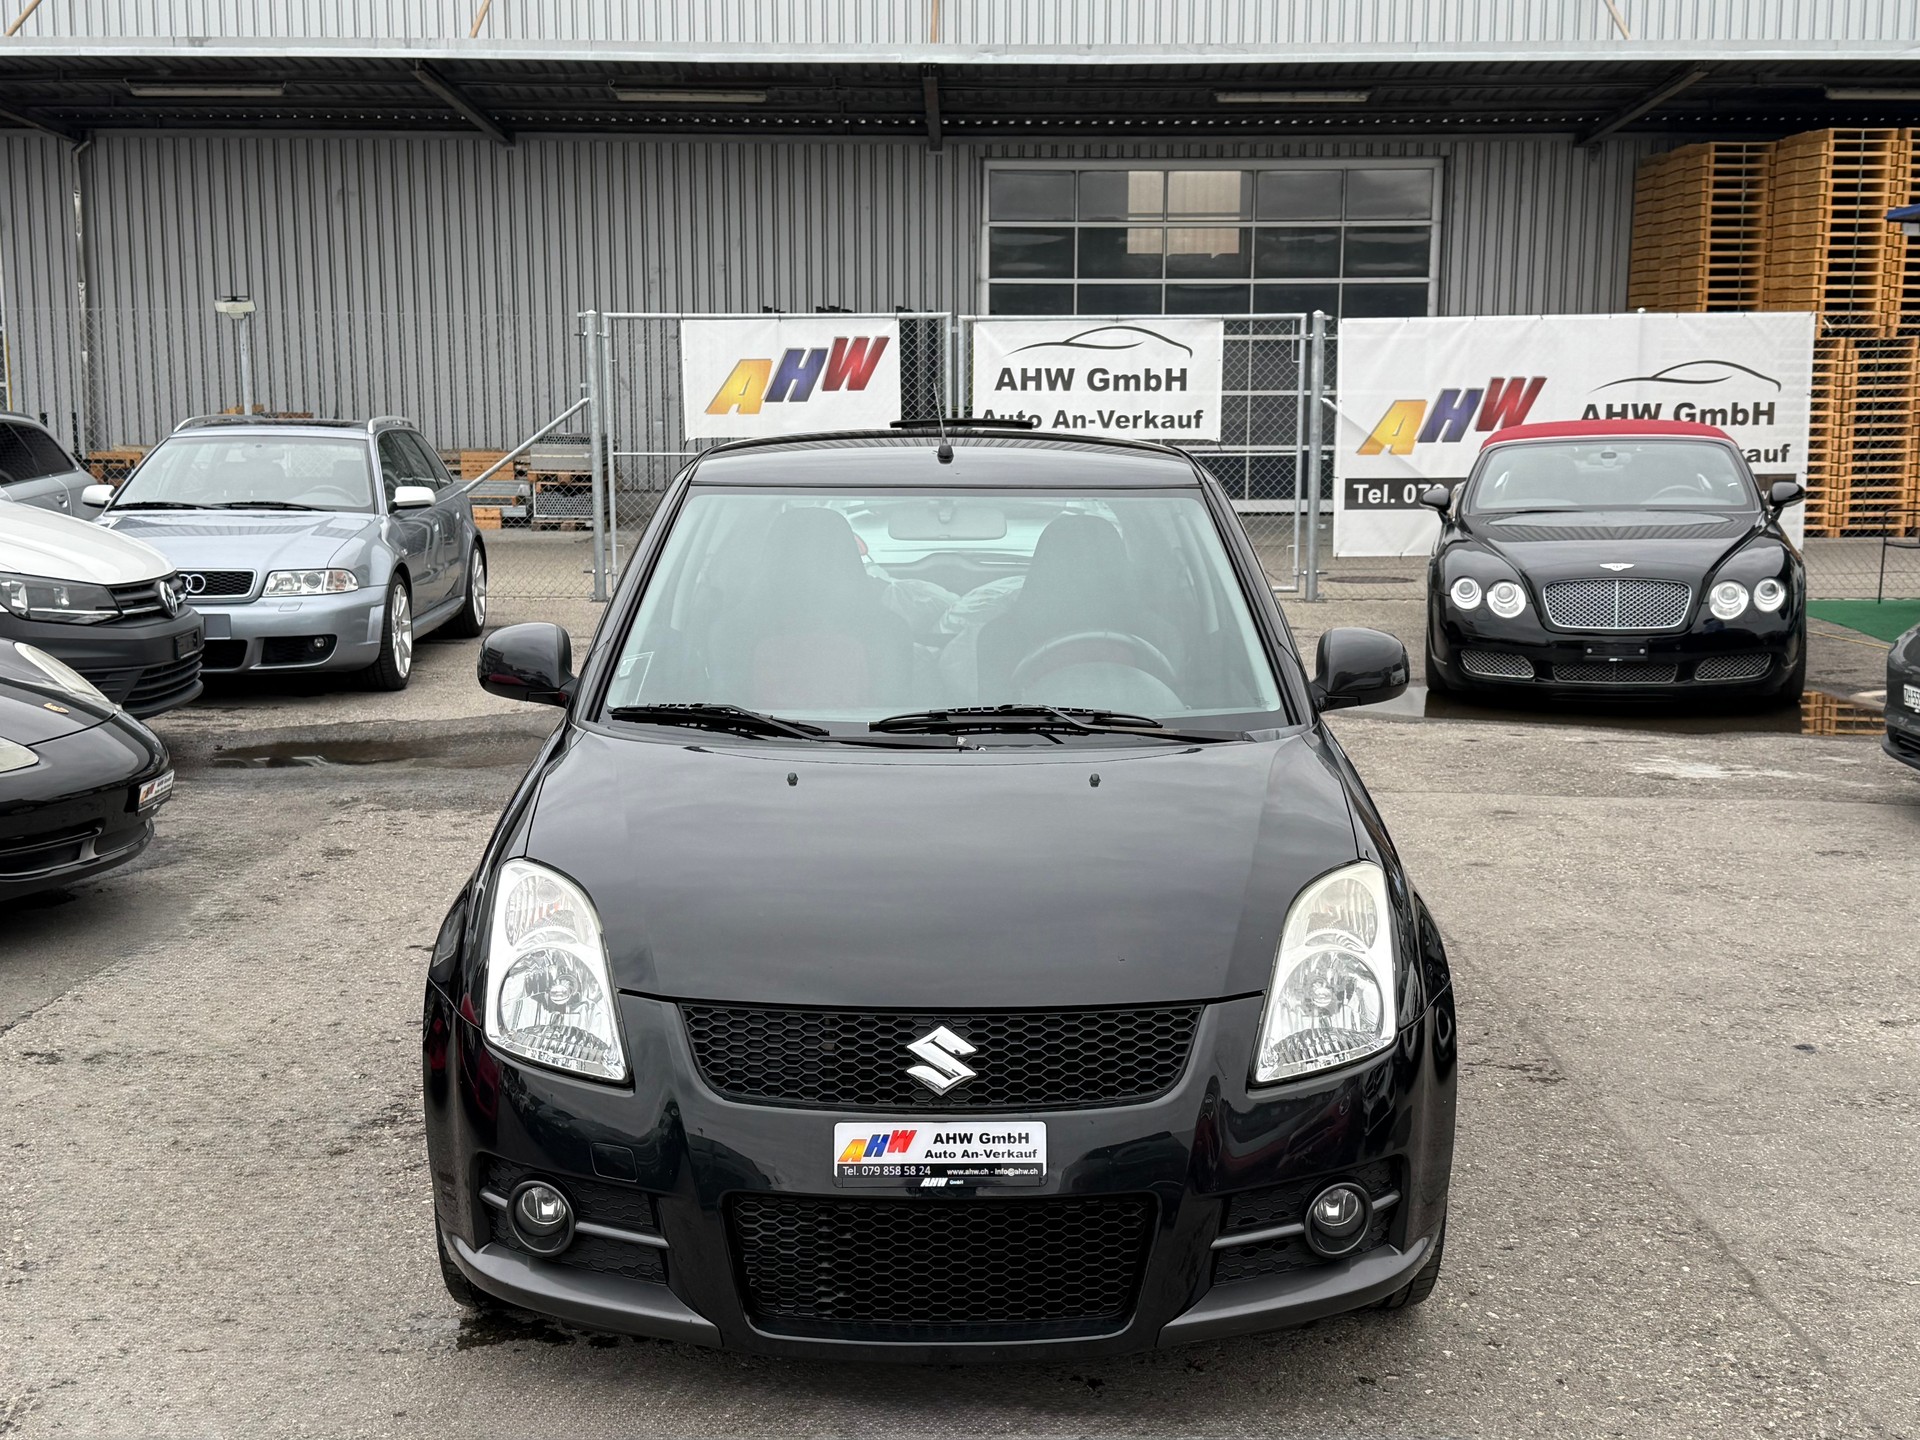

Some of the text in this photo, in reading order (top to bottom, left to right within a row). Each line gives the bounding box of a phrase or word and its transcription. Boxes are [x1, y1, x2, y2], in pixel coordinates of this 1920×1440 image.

[704, 336, 890, 415] AHW
[994, 367, 1188, 392] AHW GmbH
[1052, 409, 1204, 429] An-Verkauf
[1356, 376, 1548, 455] AHW
[1581, 402, 1775, 426] AHW GmbH
[1353, 484, 1396, 504] Tel.
[837, 1129, 918, 1163] AHW
[933, 1132, 1030, 1145] AHW GmbH
[924, 1148, 1038, 1159] Auto An-Verkauf
[843, 1166, 931, 1176] Tel. 079 858 58 24
[946, 1167, 989, 1176] www.ahw.ch
[920, 1177, 949, 1188] AHW
